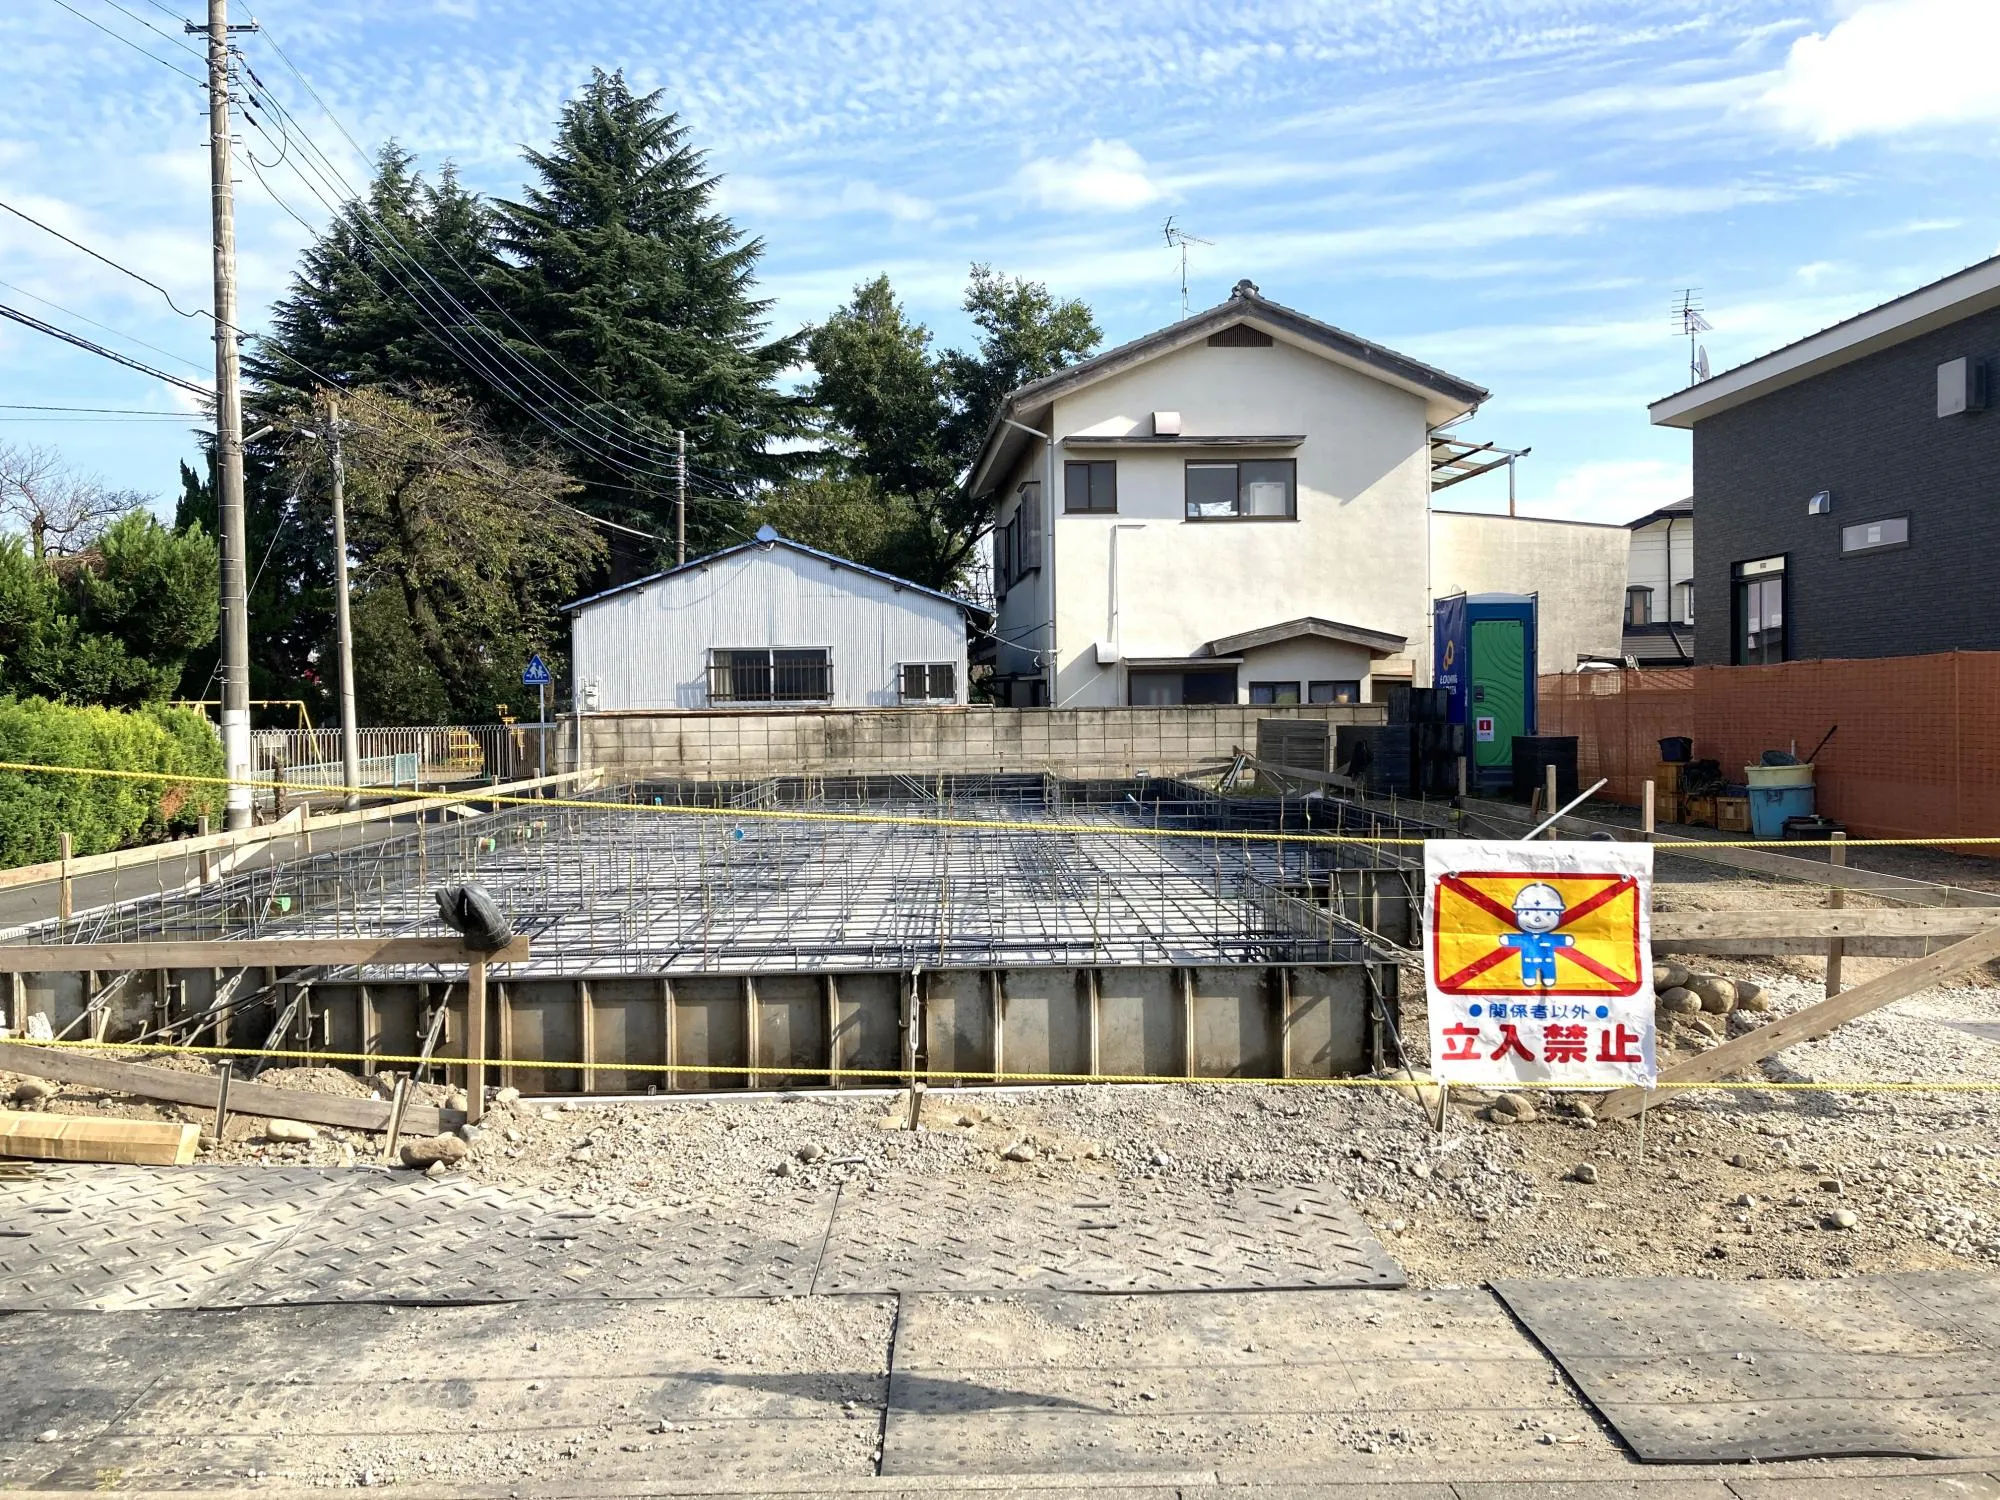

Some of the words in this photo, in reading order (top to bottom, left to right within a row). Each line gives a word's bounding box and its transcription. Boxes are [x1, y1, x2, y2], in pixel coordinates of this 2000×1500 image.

[1488, 1003, 1589, 1019] 関係者以外
[1441, 1022, 1641, 1063] 立入禁止
